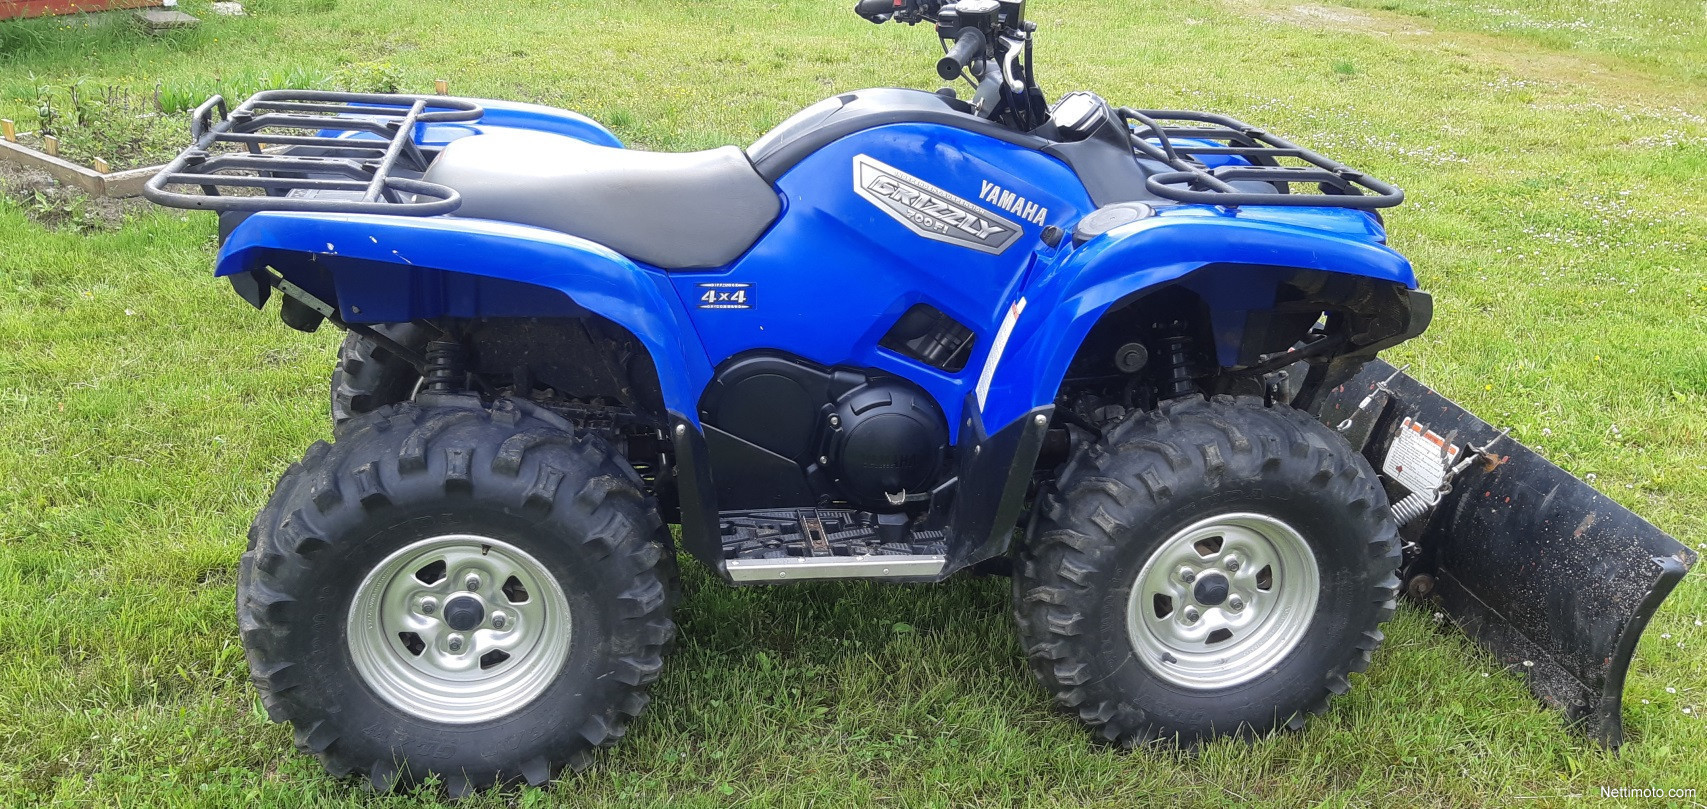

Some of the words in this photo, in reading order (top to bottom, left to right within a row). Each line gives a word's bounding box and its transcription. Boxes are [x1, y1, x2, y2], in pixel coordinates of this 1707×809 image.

[868, 175, 1007, 240] GRIZZLY
[906, 208, 934, 228] 700
[978, 179, 1049, 227] YAMAHA
